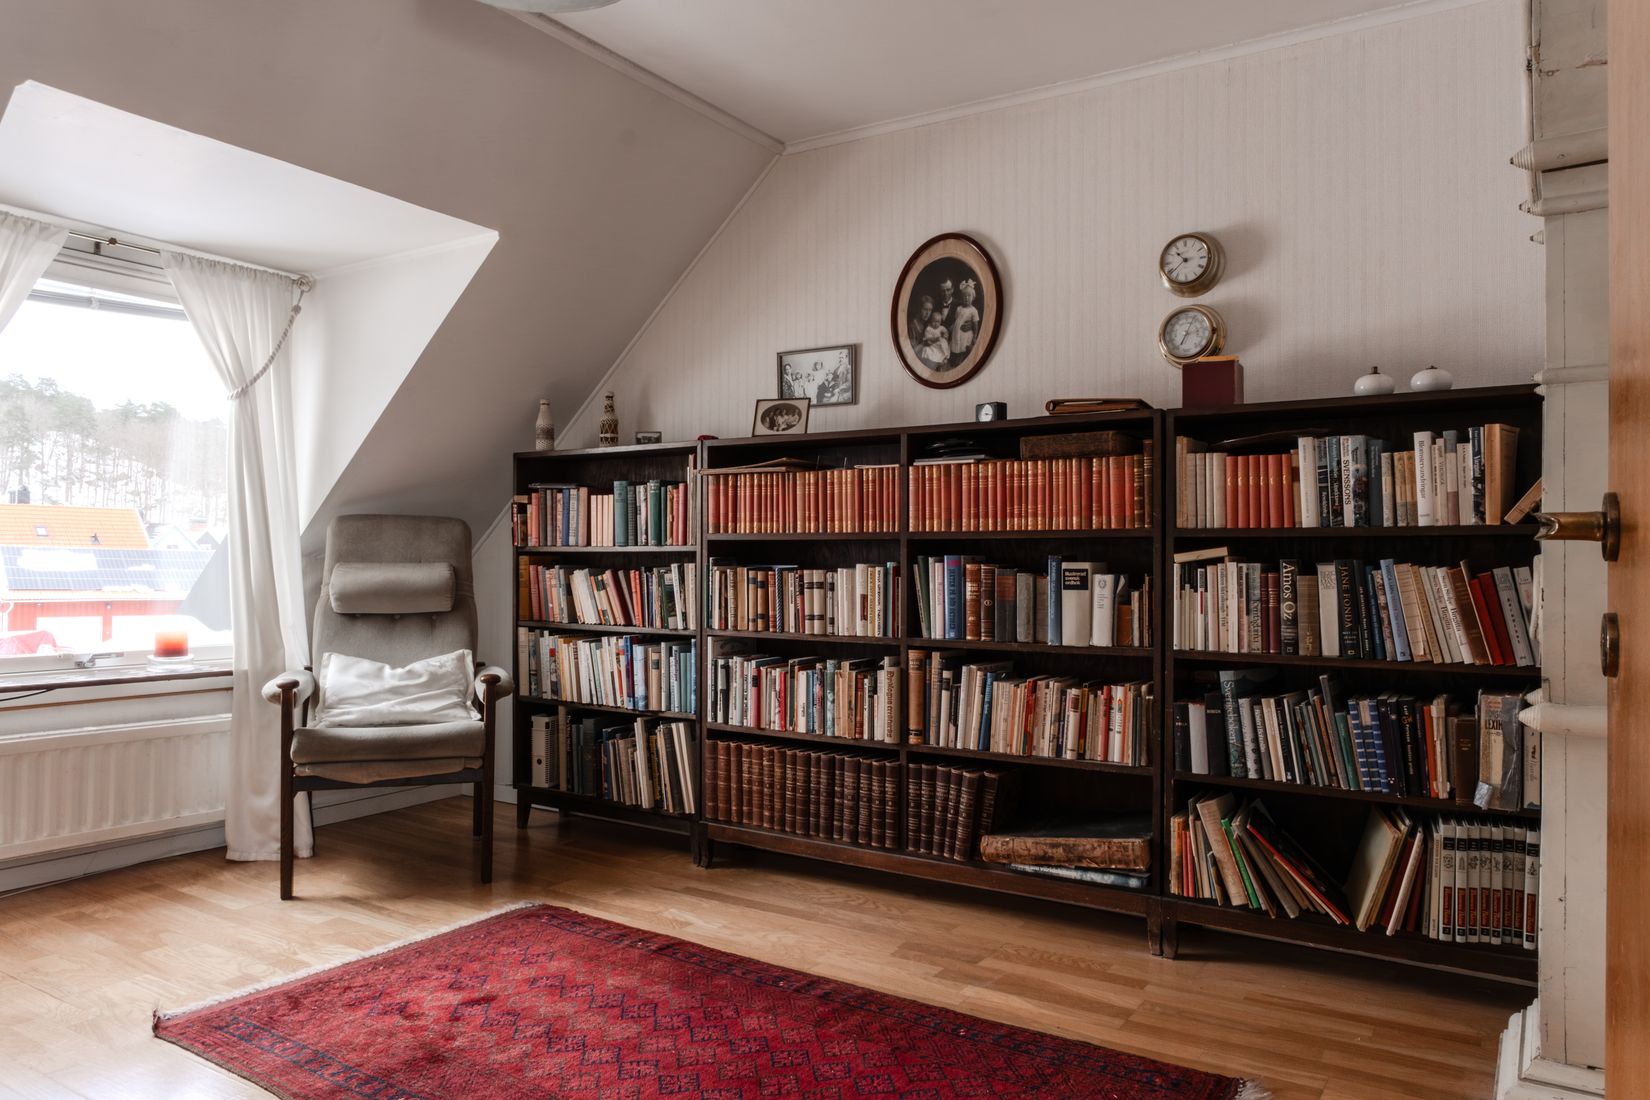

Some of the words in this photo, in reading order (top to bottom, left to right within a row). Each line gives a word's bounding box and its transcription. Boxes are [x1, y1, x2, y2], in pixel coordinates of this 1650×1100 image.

[1342, 459, 1352, 505] SVENSSONS
[1282, 562, 1296, 599] Amos
[1338, 566, 1350, 591] JANE
[1283, 601, 1296, 620] Oz
[1343, 594, 1353, 629] FONDA
[1223, 681, 1239, 744] Sverigeboken
